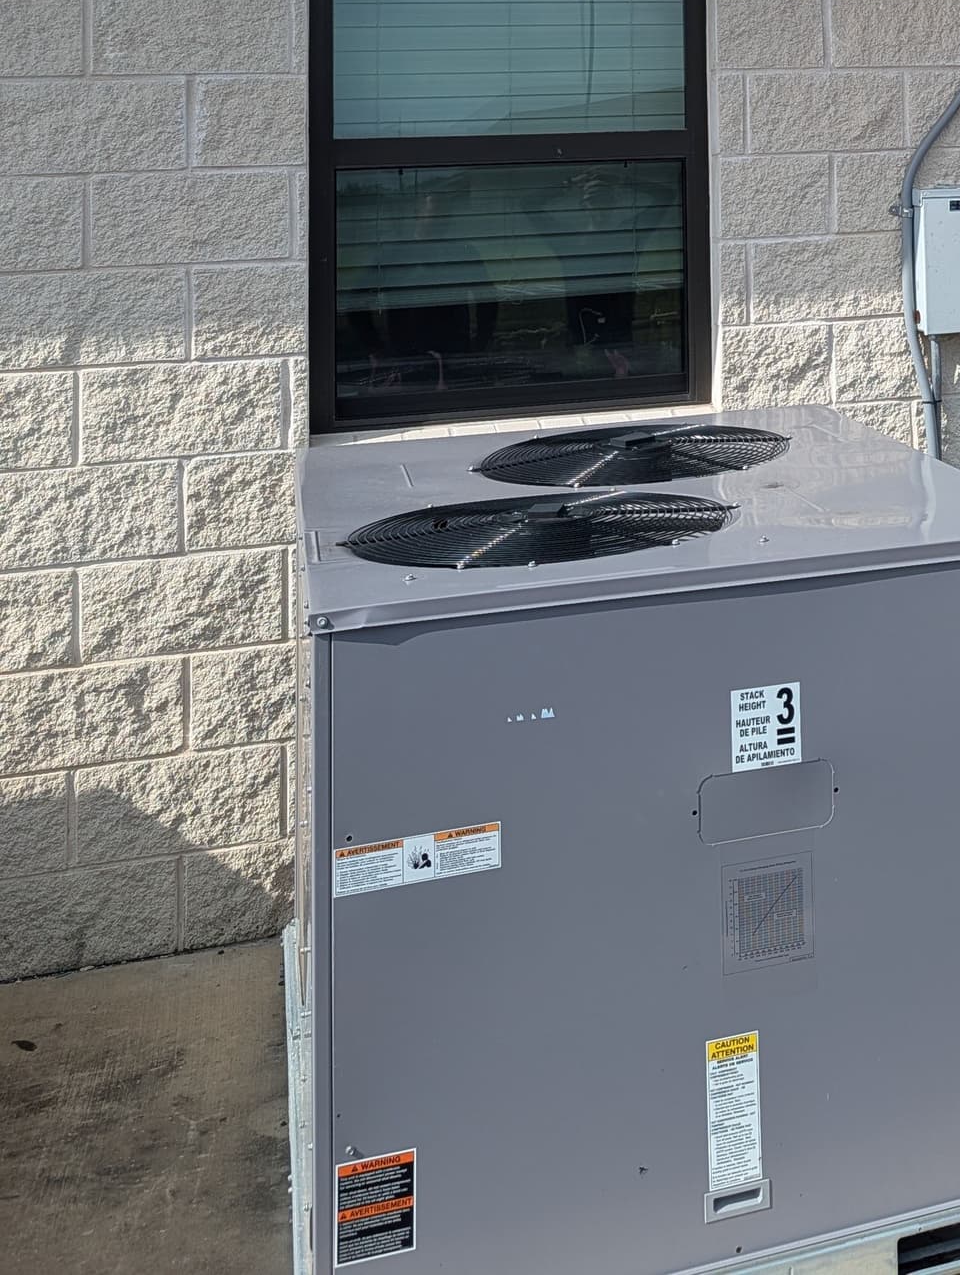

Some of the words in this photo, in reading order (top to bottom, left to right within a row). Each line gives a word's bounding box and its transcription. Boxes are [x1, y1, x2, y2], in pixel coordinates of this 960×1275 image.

[740, 690, 765, 701] STACK
[738, 700, 766, 712] HEIGHT
[776, 687, 795, 725] 3
[735, 715, 771, 728] HAUTEUR
[739, 728, 750, 738] DE
[751, 726, 768, 736] PILE
[739, 741, 768, 753] ALTURA
[735, 754, 745, 764] DE
[746, 747, 795, 763] APILAMIENTO
[454, 826, 487, 837] WARNING
[714, 1036, 750, 1050] CAUTION
[711, 1044, 754, 1059] ATTENTION
[361, 1155, 401, 1171] WARNING
[350, 1199, 412, 1218] AVERTISSEMENT
